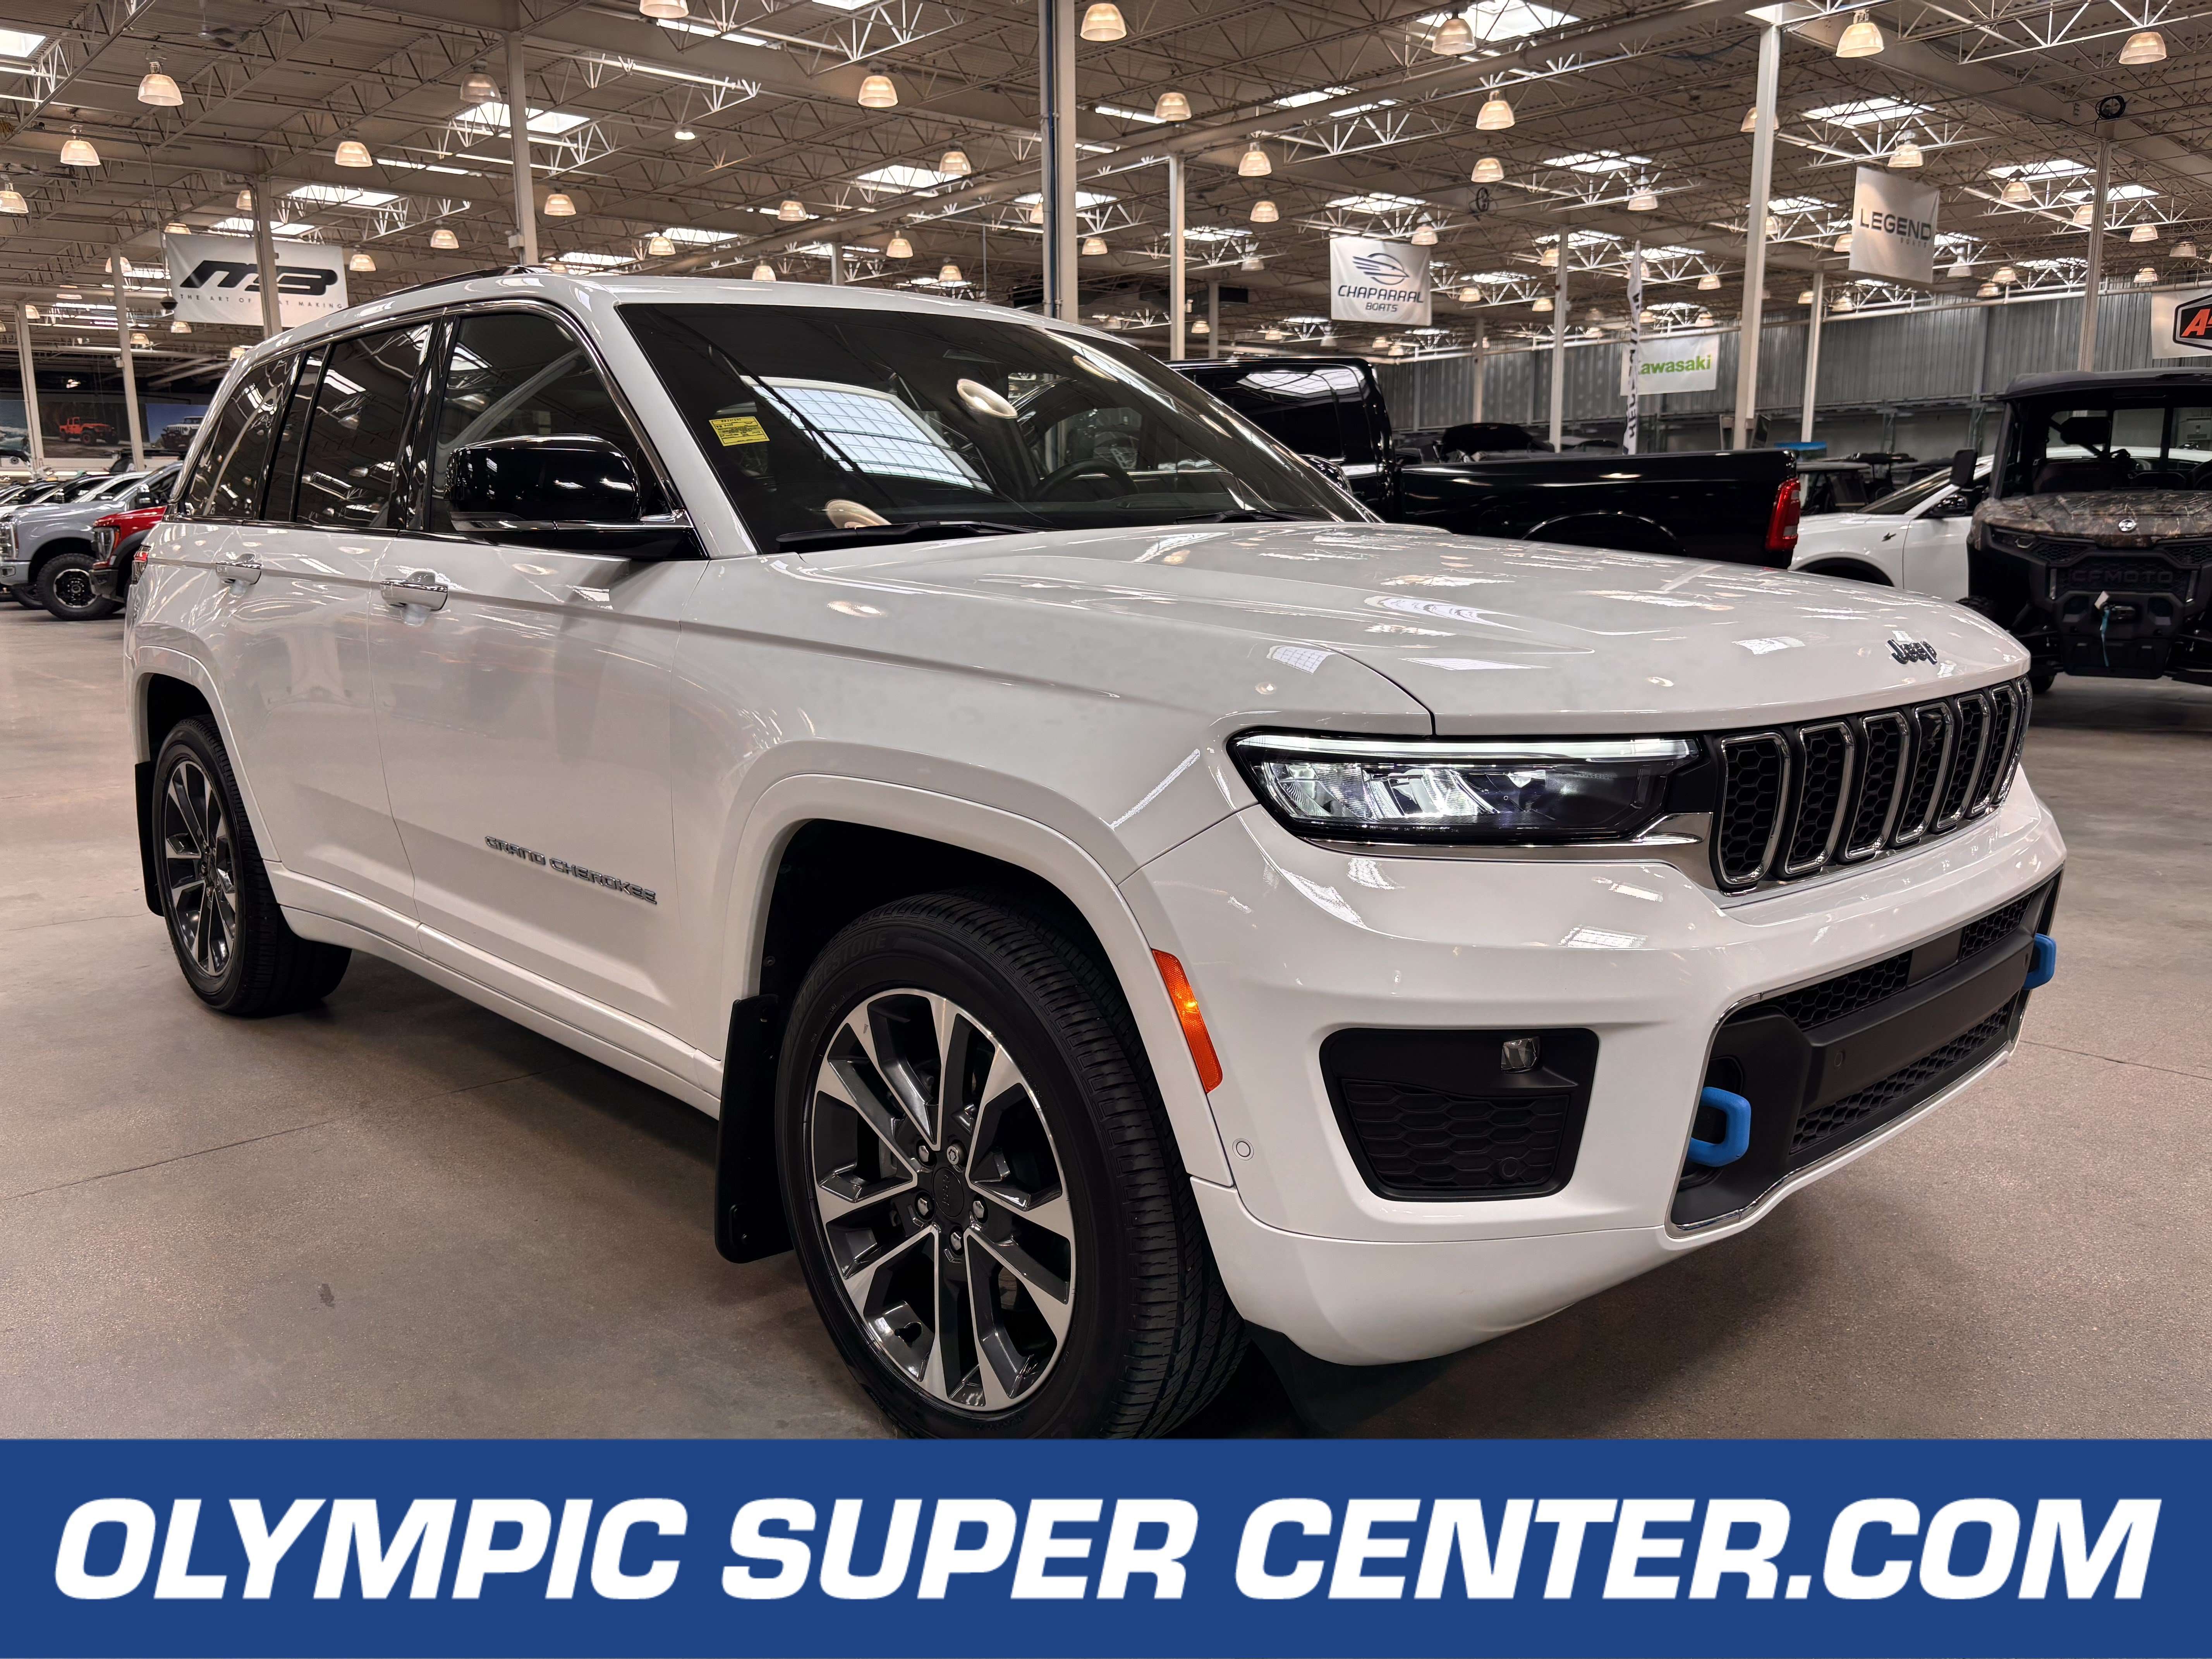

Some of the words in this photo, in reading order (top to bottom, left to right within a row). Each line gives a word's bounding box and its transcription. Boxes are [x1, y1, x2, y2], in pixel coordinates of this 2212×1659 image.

[1860, 208, 1932, 241] LEGEND
[1338, 285, 1424, 303] CHAPARRAL
[1365, 302, 1398, 312] BOATS
[1638, 354, 1711, 375] awasaki
[2071, 570, 2174, 584] CFMOTO
[1885, 639, 1937, 665] Jeep
[484, 835, 546, 866] GRAND
[549, 857, 658, 905] CHEROKEE
[785, 930, 888, 1050] BRIDGESTONE
